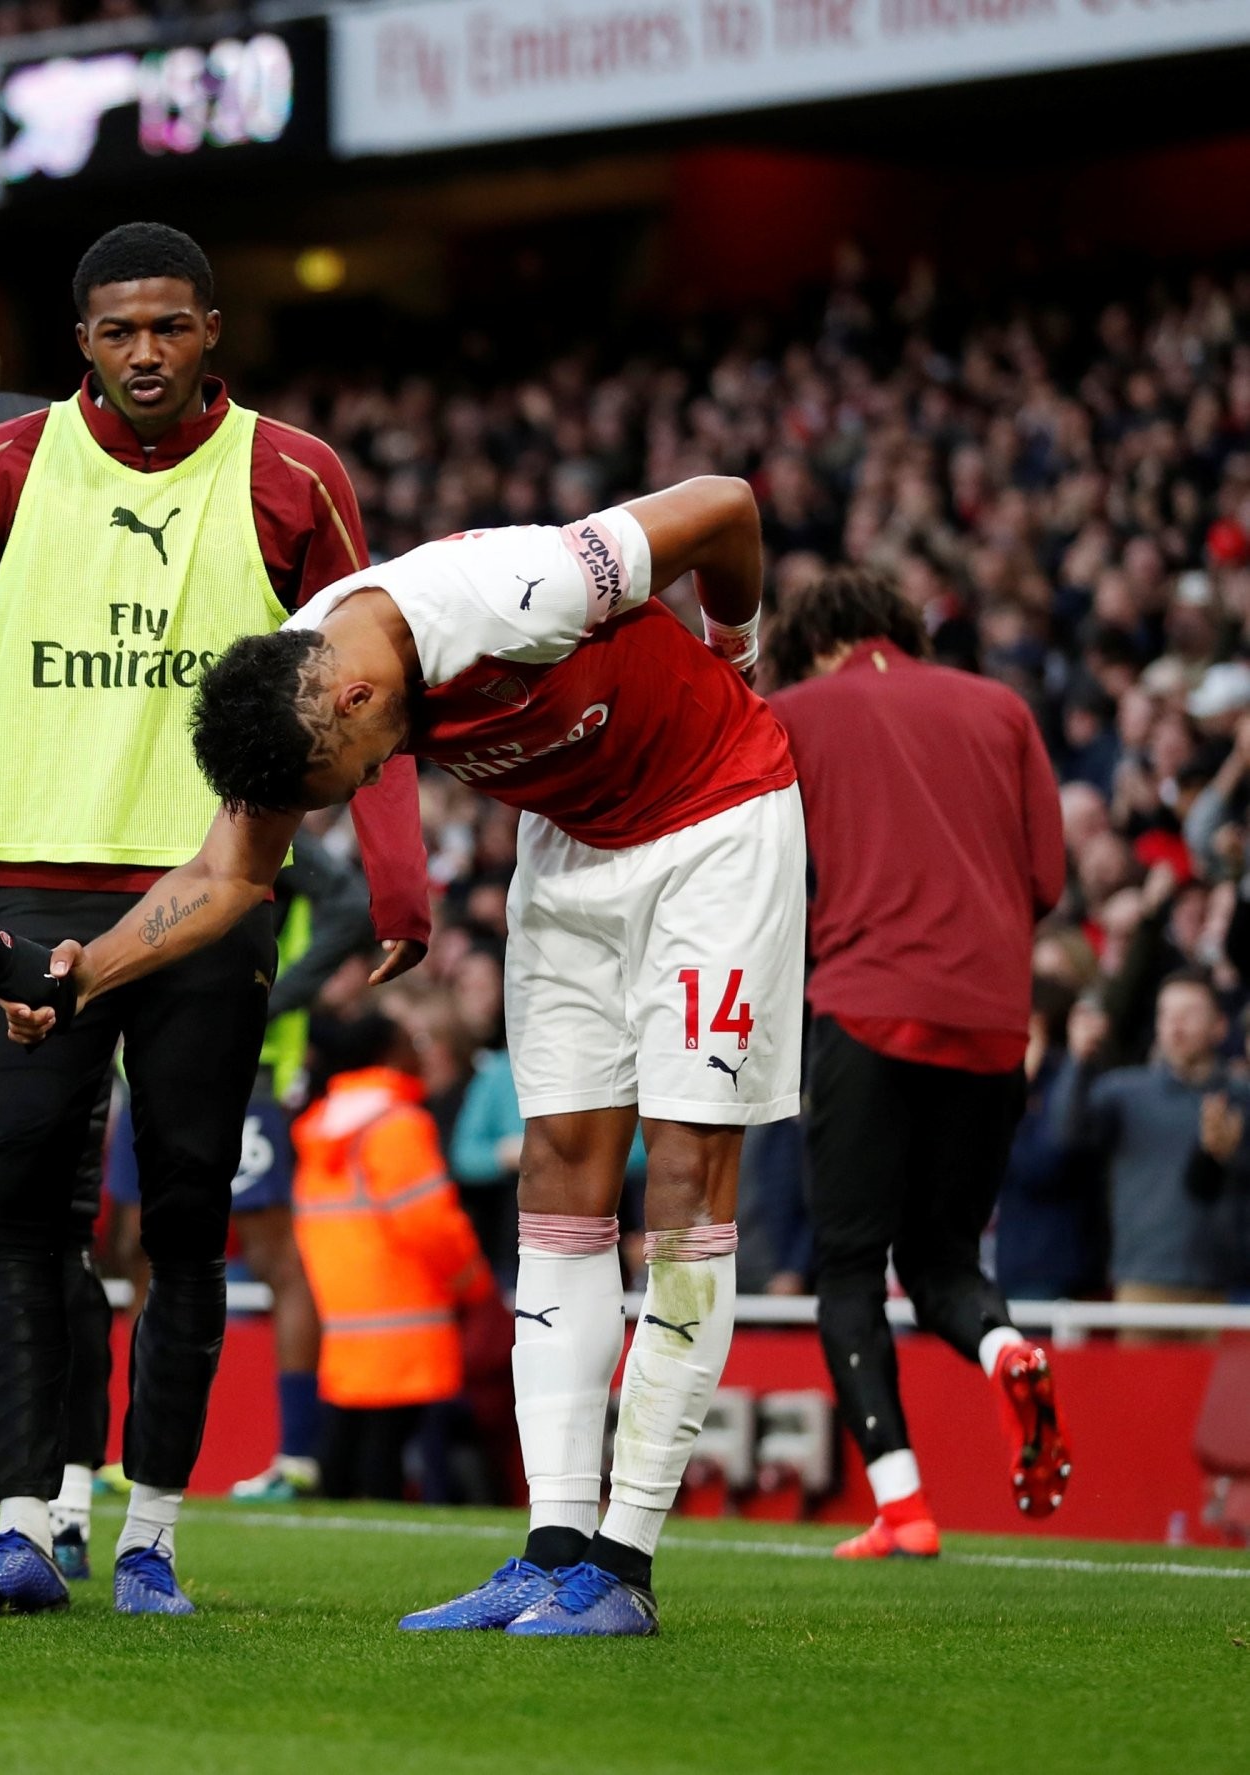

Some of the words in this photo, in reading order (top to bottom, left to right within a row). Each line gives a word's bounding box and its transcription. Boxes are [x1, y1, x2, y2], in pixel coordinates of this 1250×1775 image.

[578, 550, 609, 601] VISIT
[109, 602, 169, 641] Fly
[677, 968, 755, 1050] 14
